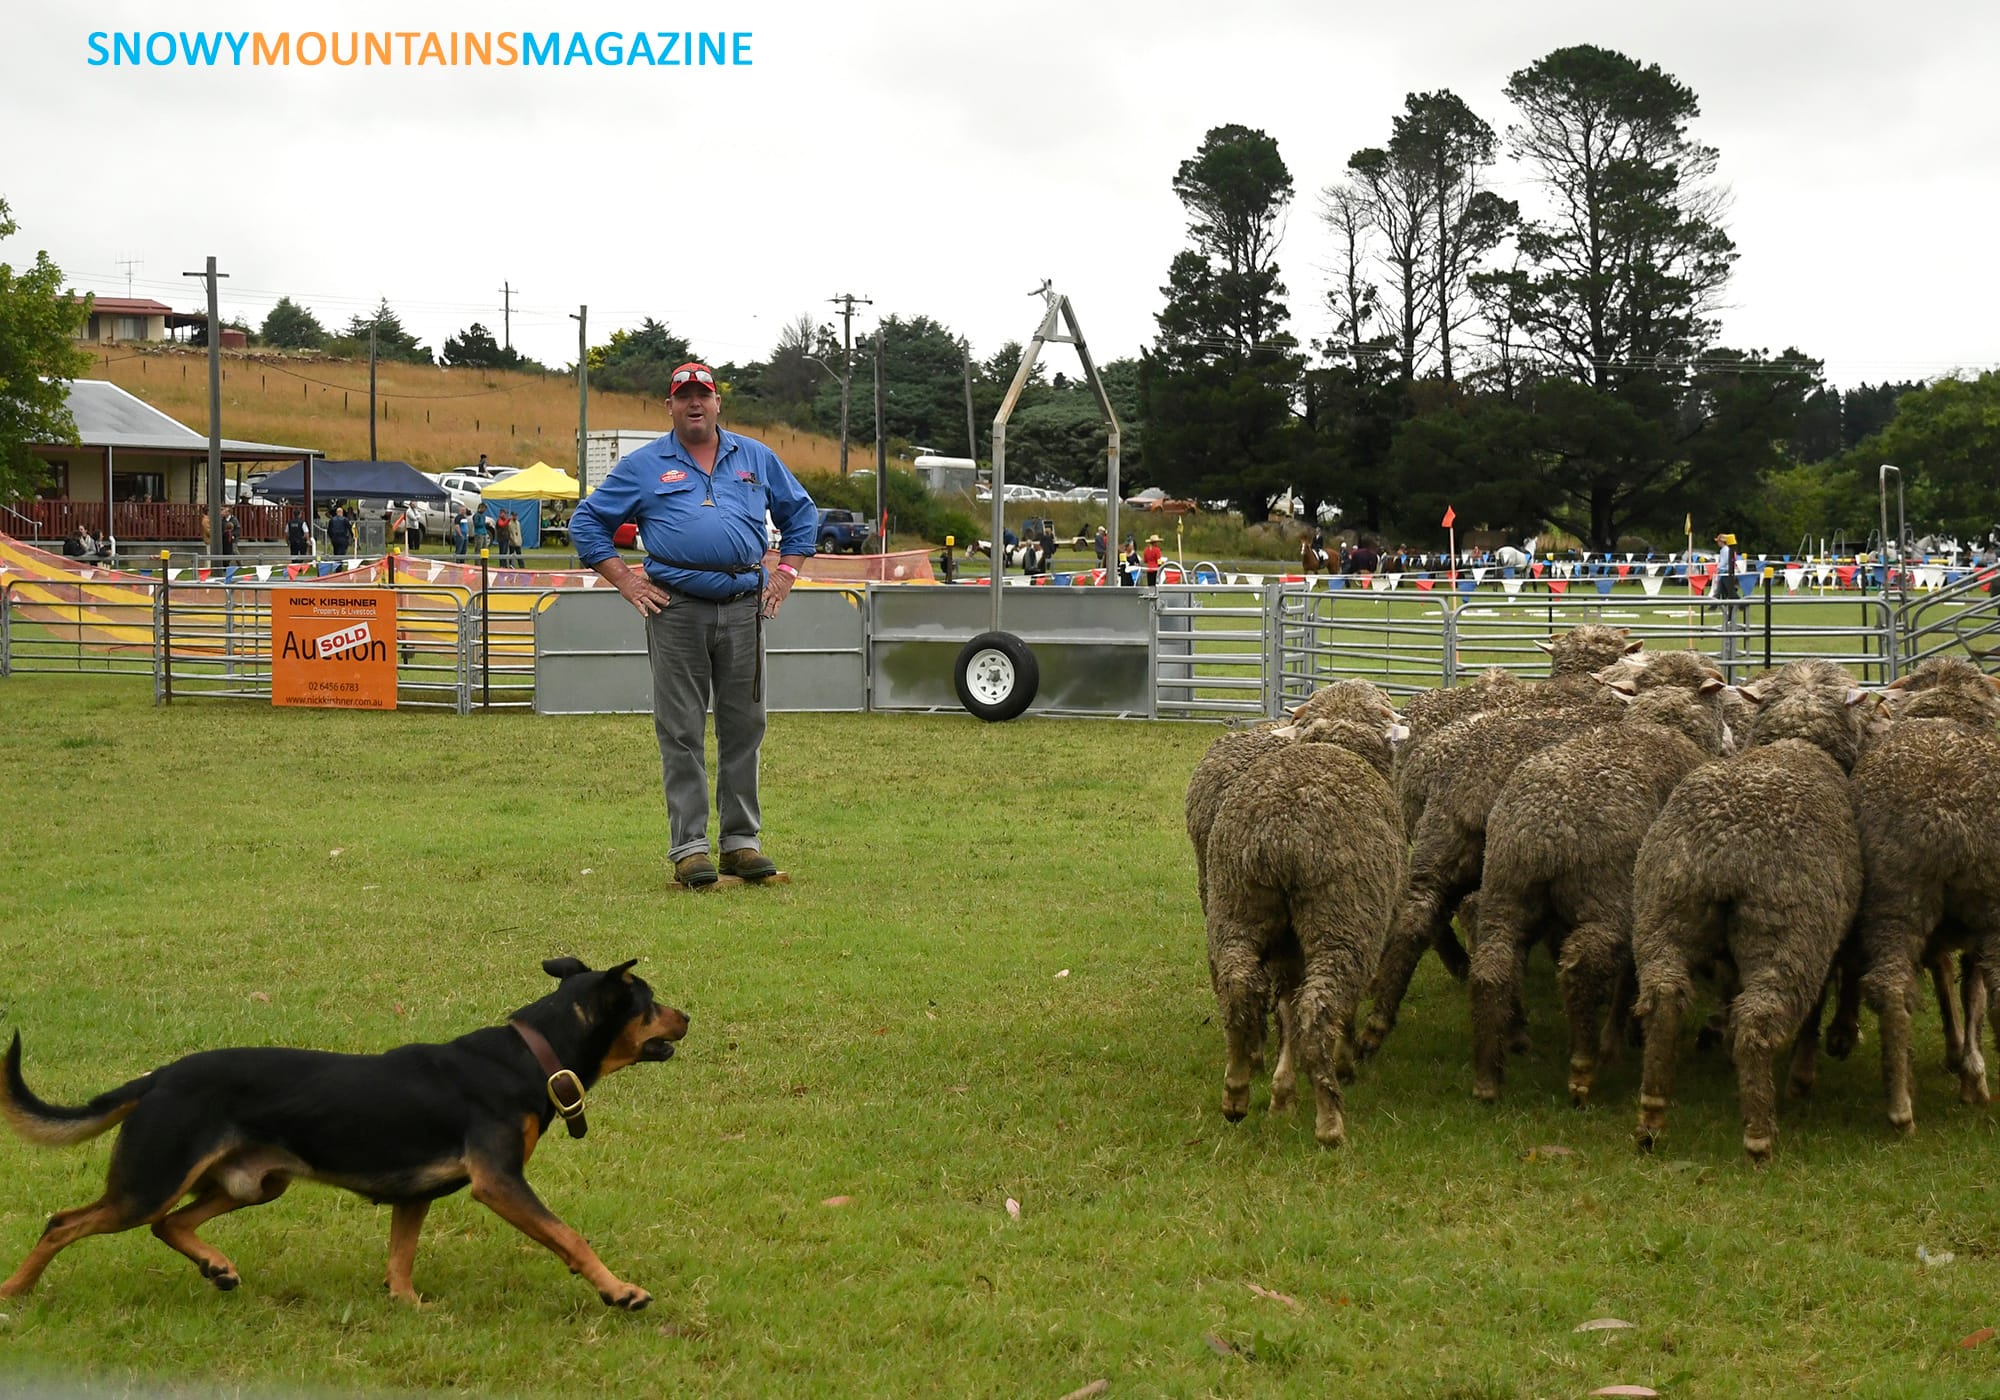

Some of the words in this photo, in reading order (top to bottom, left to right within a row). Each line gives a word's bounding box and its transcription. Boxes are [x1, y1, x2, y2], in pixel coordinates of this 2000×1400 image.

[290, 598, 316, 606] NICK
[320, 598, 377, 607] KIRSHNER
[313, 607, 340, 616] Property
[341, 607, 347, 615] &
[347, 607, 377, 616] Livestock
[321, 628, 367, 652] SOLD
[282, 630, 386, 662] Auion
[308, 681, 318, 691] 02
[319, 682, 339, 691] 6456
[340, 682, 359, 692] 6783
[285, 695, 383, 707] www.nickkirshner.com.au
